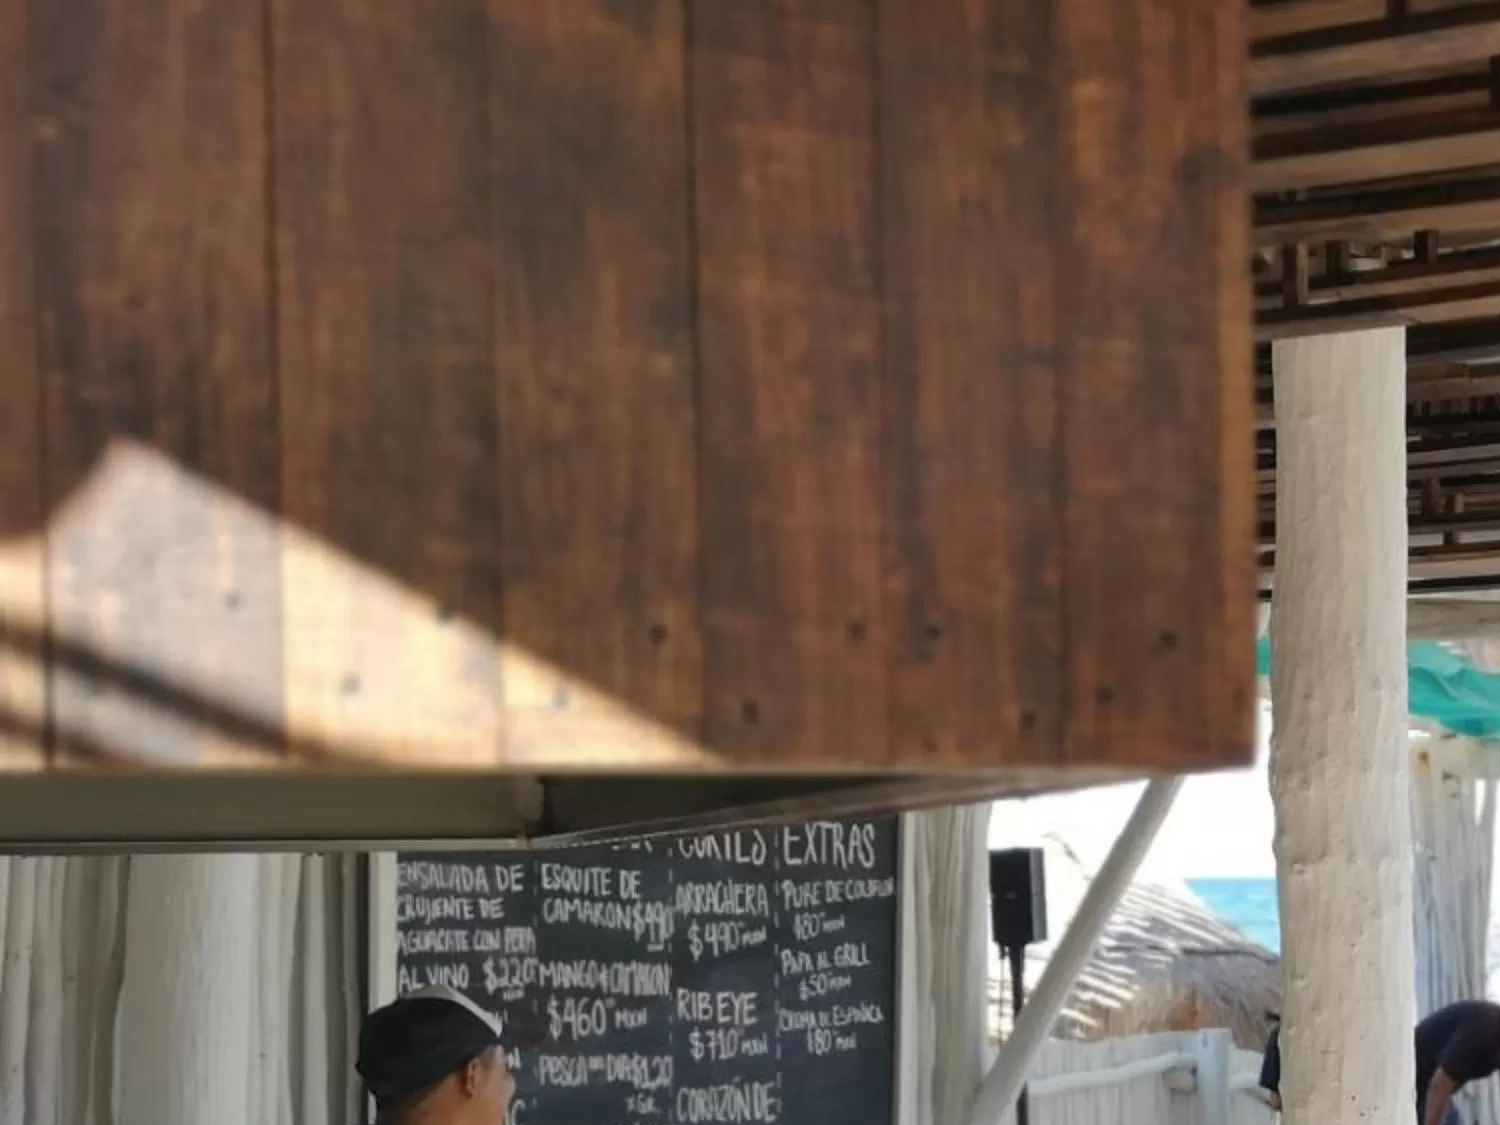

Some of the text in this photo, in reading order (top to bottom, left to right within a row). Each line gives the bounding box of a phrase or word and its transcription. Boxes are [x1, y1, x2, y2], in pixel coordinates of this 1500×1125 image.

[783, 820, 876, 871] EXTRAS
[495, 864, 524, 893] DE
[541, 863, 641, 899] ESQUITE DE
[479, 898, 505, 919] DE
[399, 963, 424, 993] AL
[426, 961, 469, 990] VINO
[677, 987, 758, 1025] RIB EYE
[752, 1078, 777, 1123] DE
